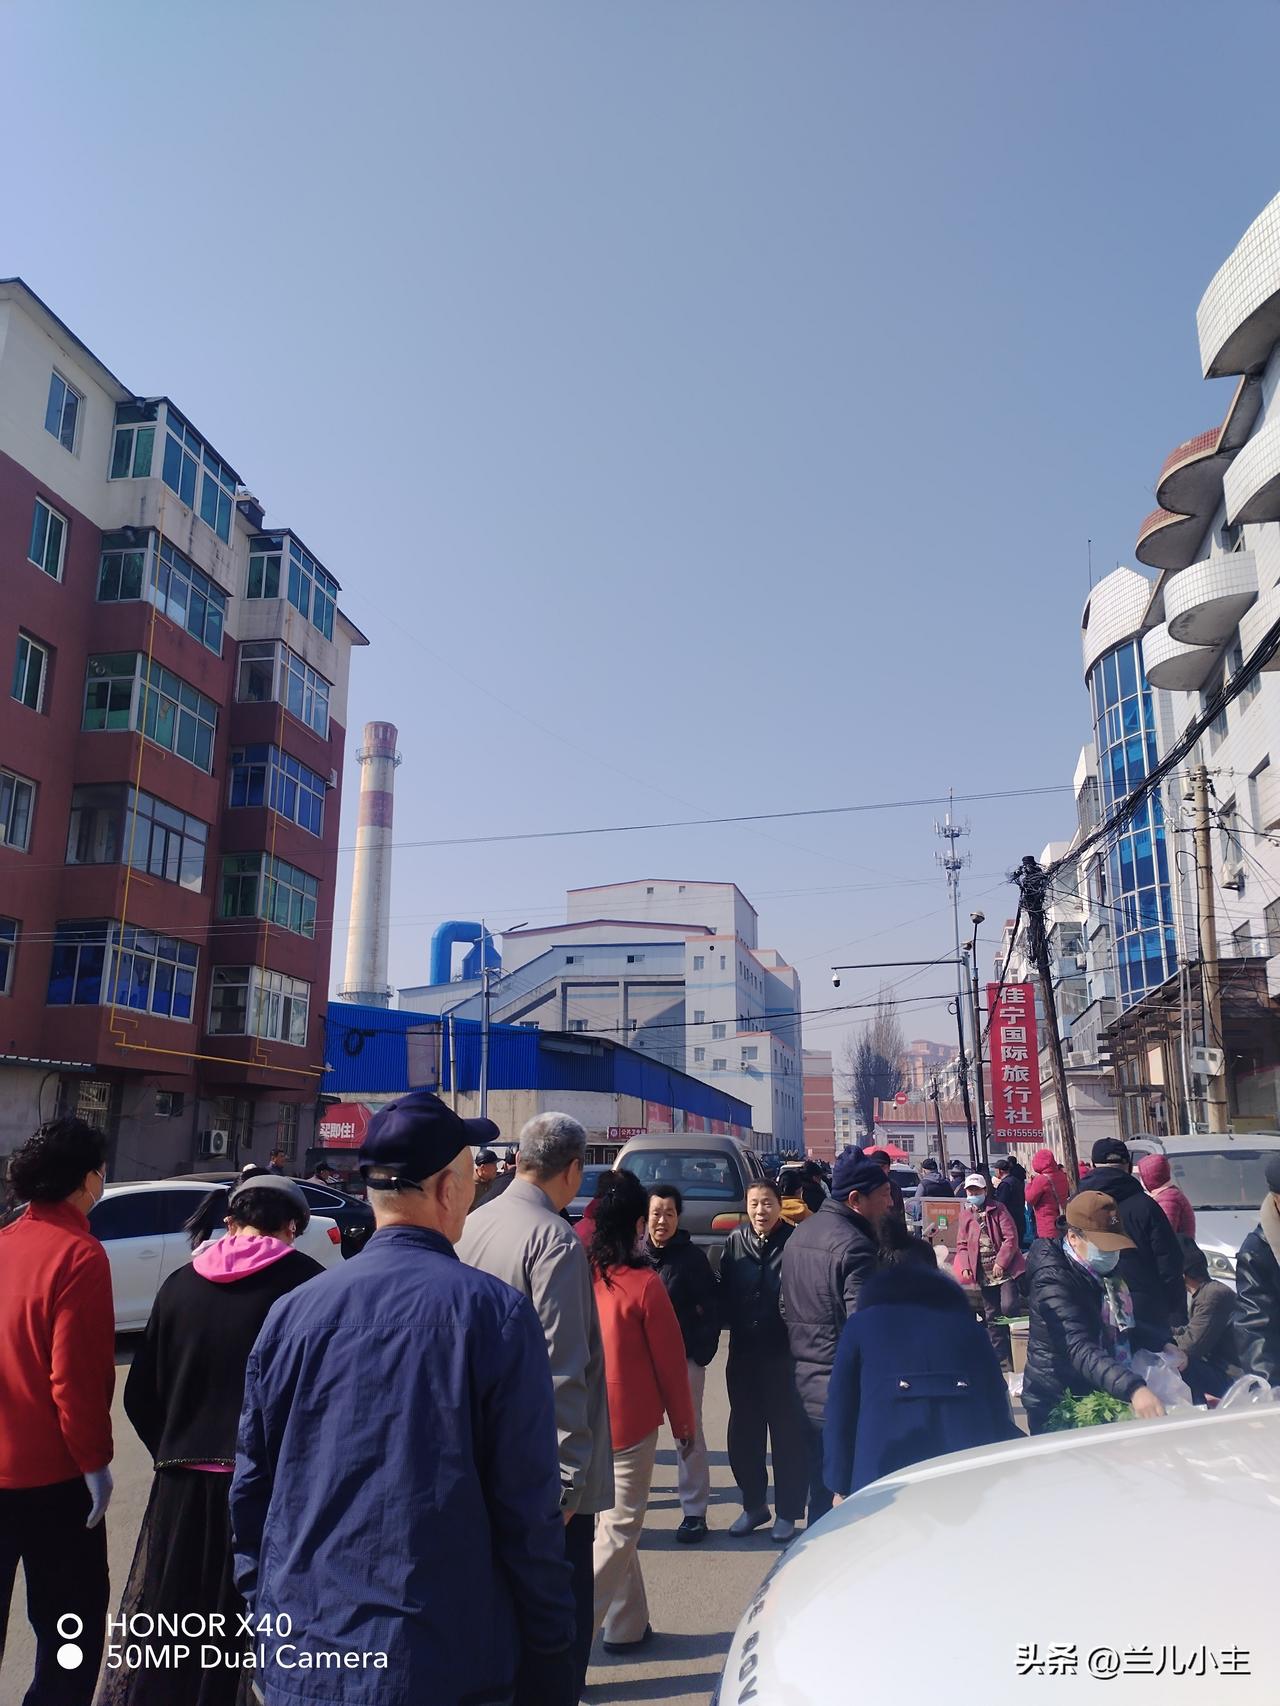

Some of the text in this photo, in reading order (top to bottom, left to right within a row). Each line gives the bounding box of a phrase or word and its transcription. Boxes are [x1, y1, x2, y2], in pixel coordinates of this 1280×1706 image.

[999, 987, 1034, 1125] 佳宁国际旅行社
